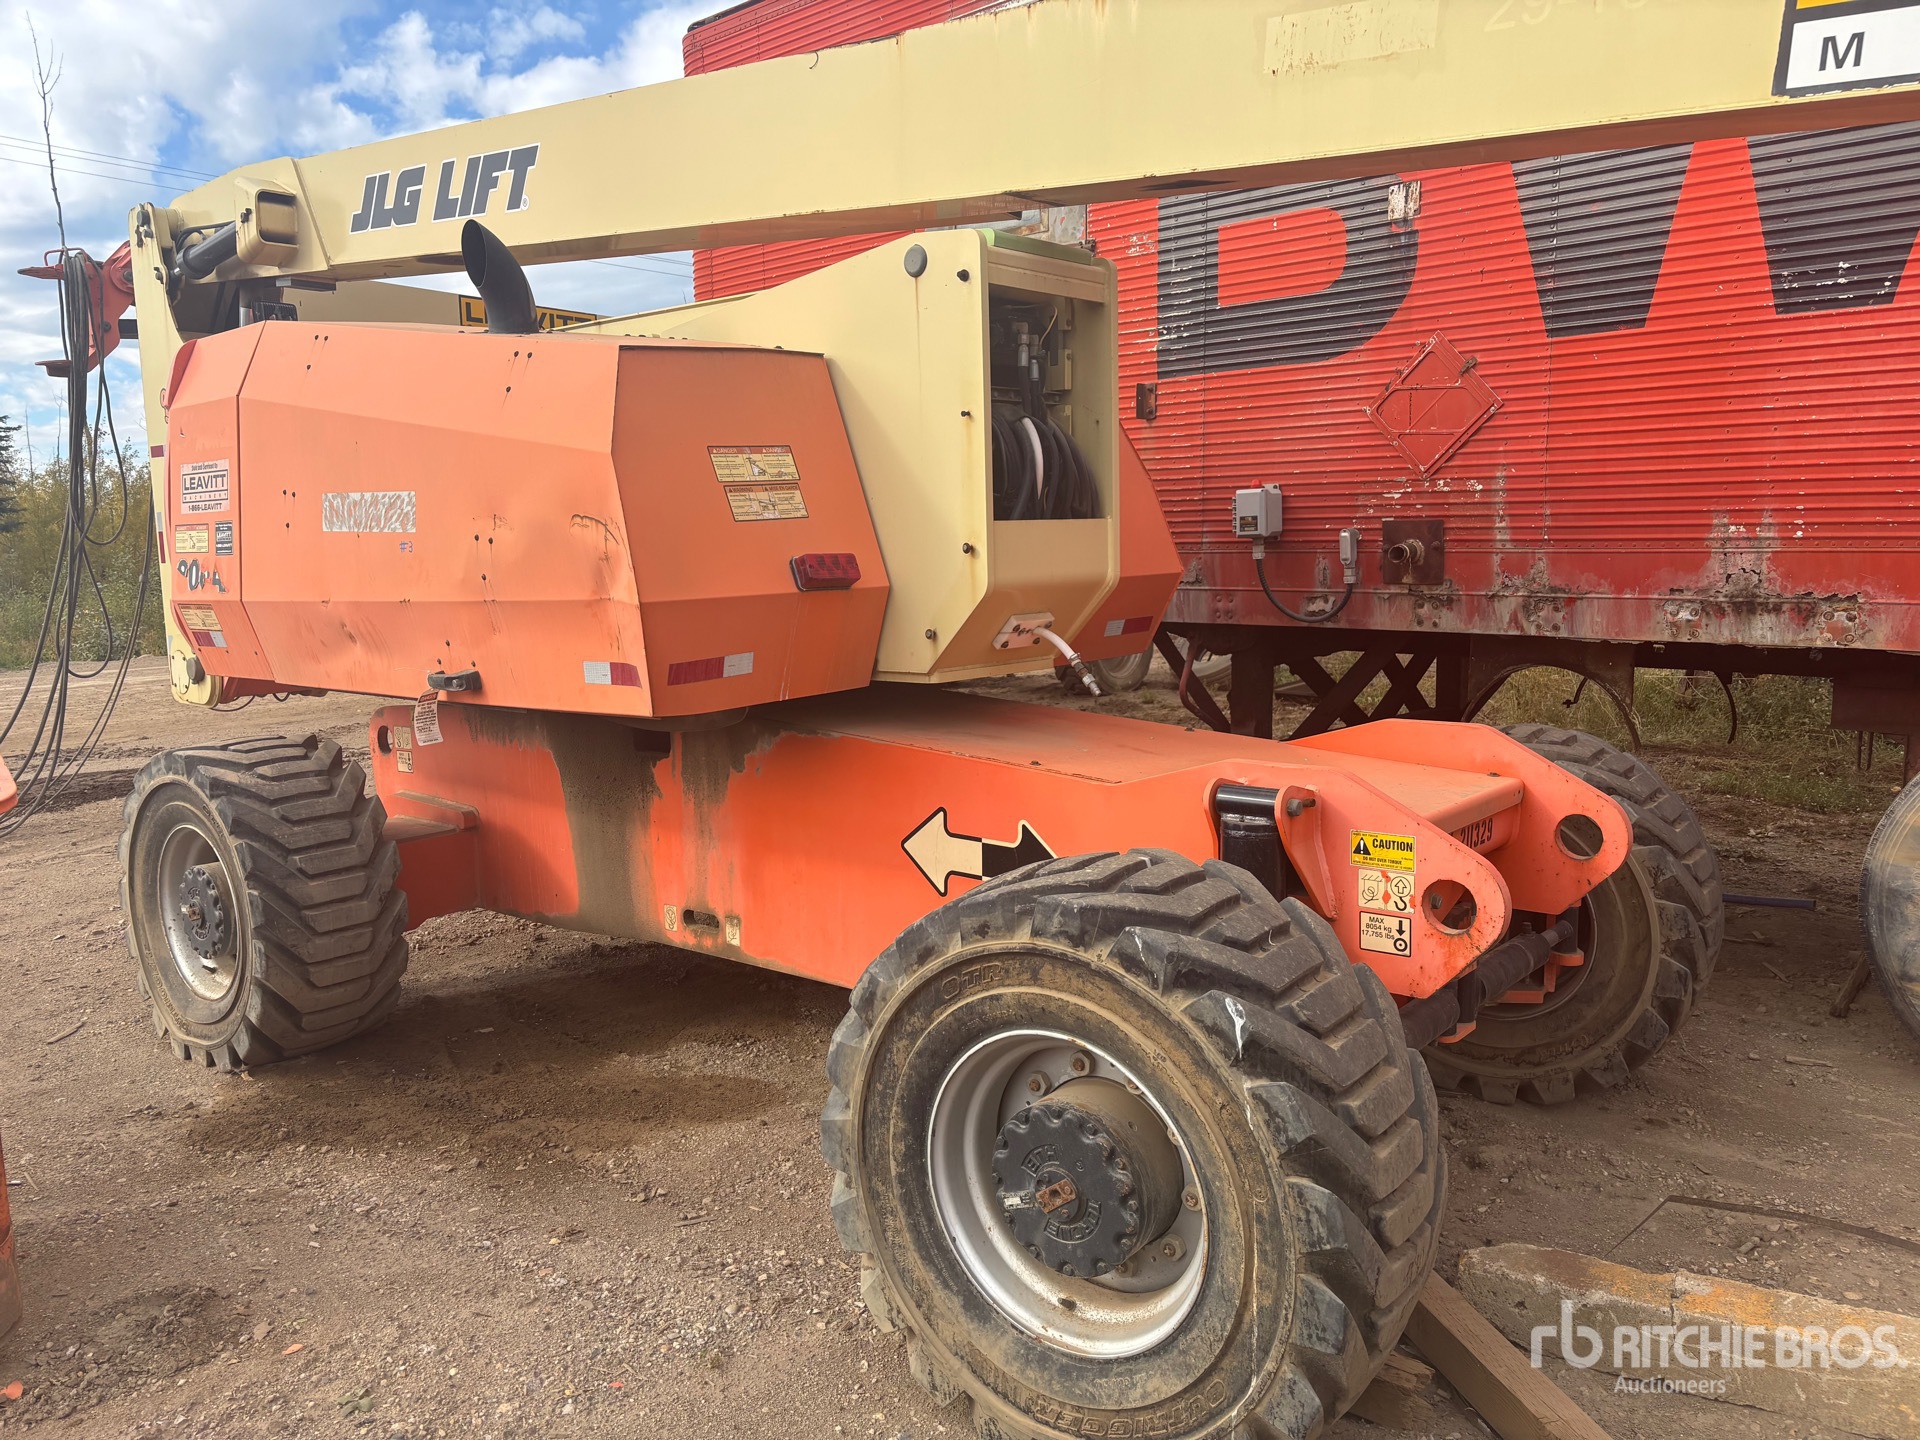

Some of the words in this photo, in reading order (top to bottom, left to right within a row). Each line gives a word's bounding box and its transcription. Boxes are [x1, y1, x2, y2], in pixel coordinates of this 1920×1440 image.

[1818, 31, 1865, 71] M
[351, 165, 426, 233] JLG
[184, 474, 226, 490] LEAVITT
[1372, 838, 1413, 852] CAUTION
[1369, 916, 1385, 924] MAX
[1362, 929, 1383, 938] 17,755
[1384, 932, 1395, 940] lbs
[1383, 925, 1392, 933] kg
